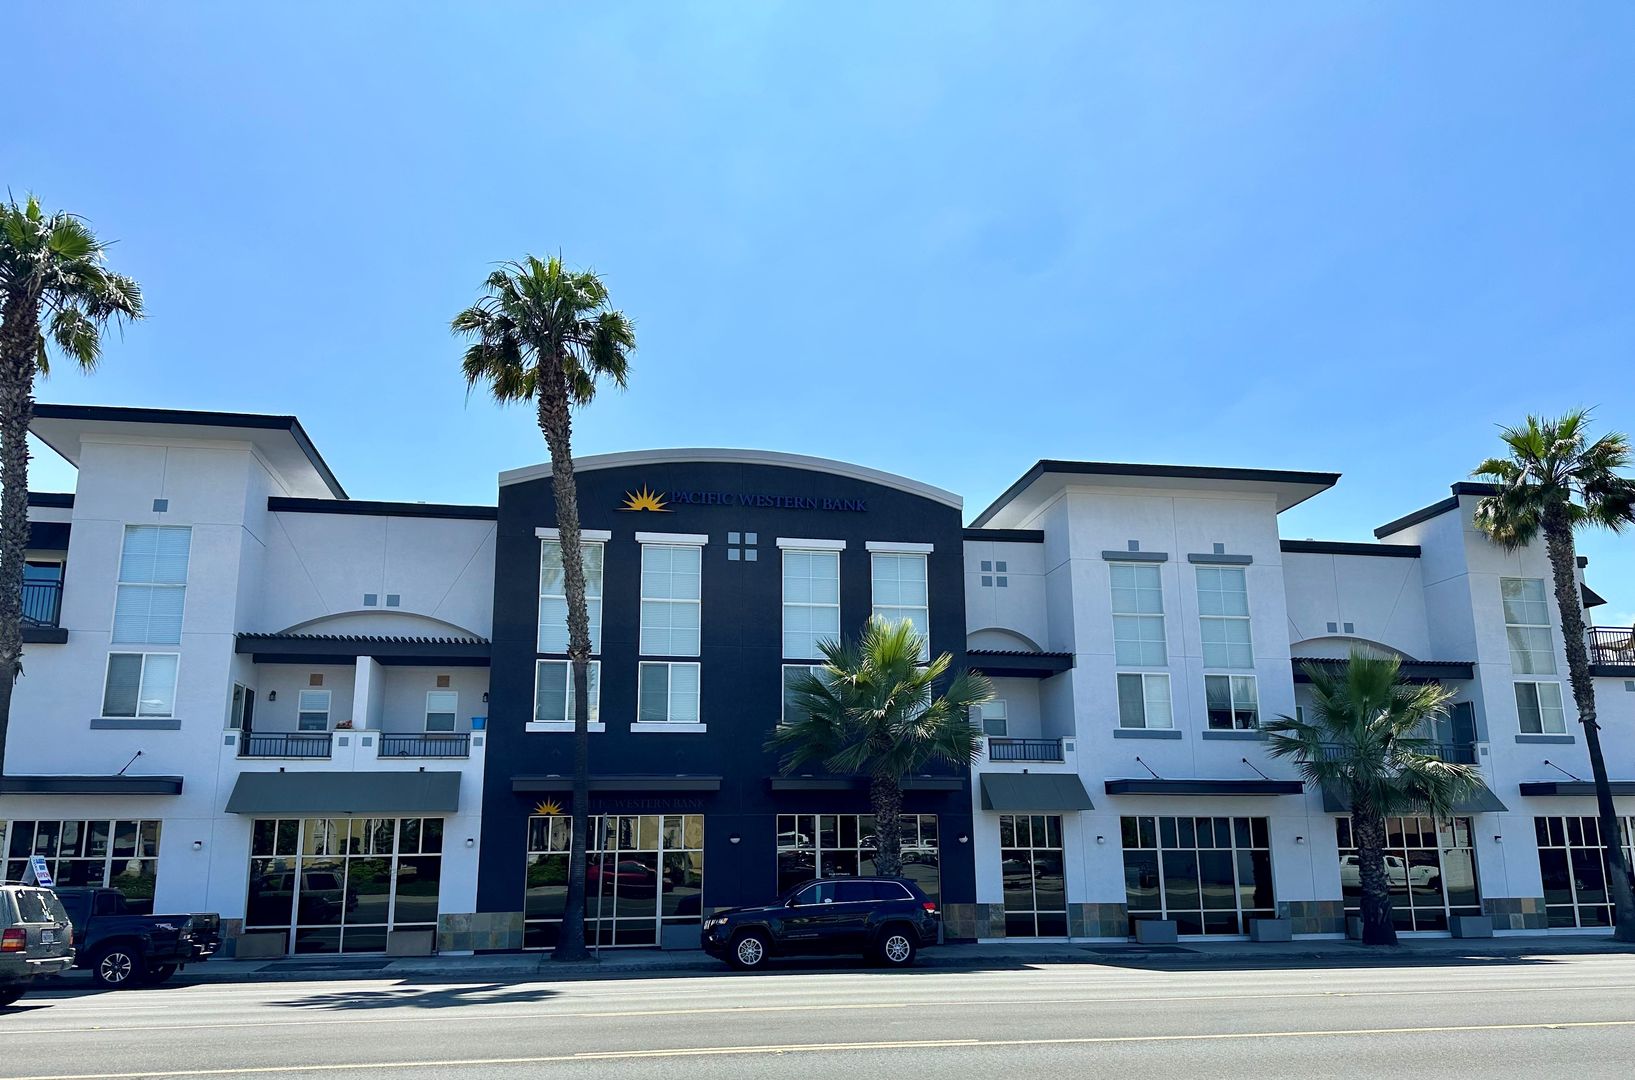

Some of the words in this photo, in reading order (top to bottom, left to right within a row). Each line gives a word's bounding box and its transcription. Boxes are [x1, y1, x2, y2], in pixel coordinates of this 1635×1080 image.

[671, 490, 734, 505] PACIFIC
[738, 494, 817, 509] WESTERN
[822, 497, 867, 512] BANK
[615, 799, 671, 809] WESTERN
[672, 799, 704, 809] BANK
